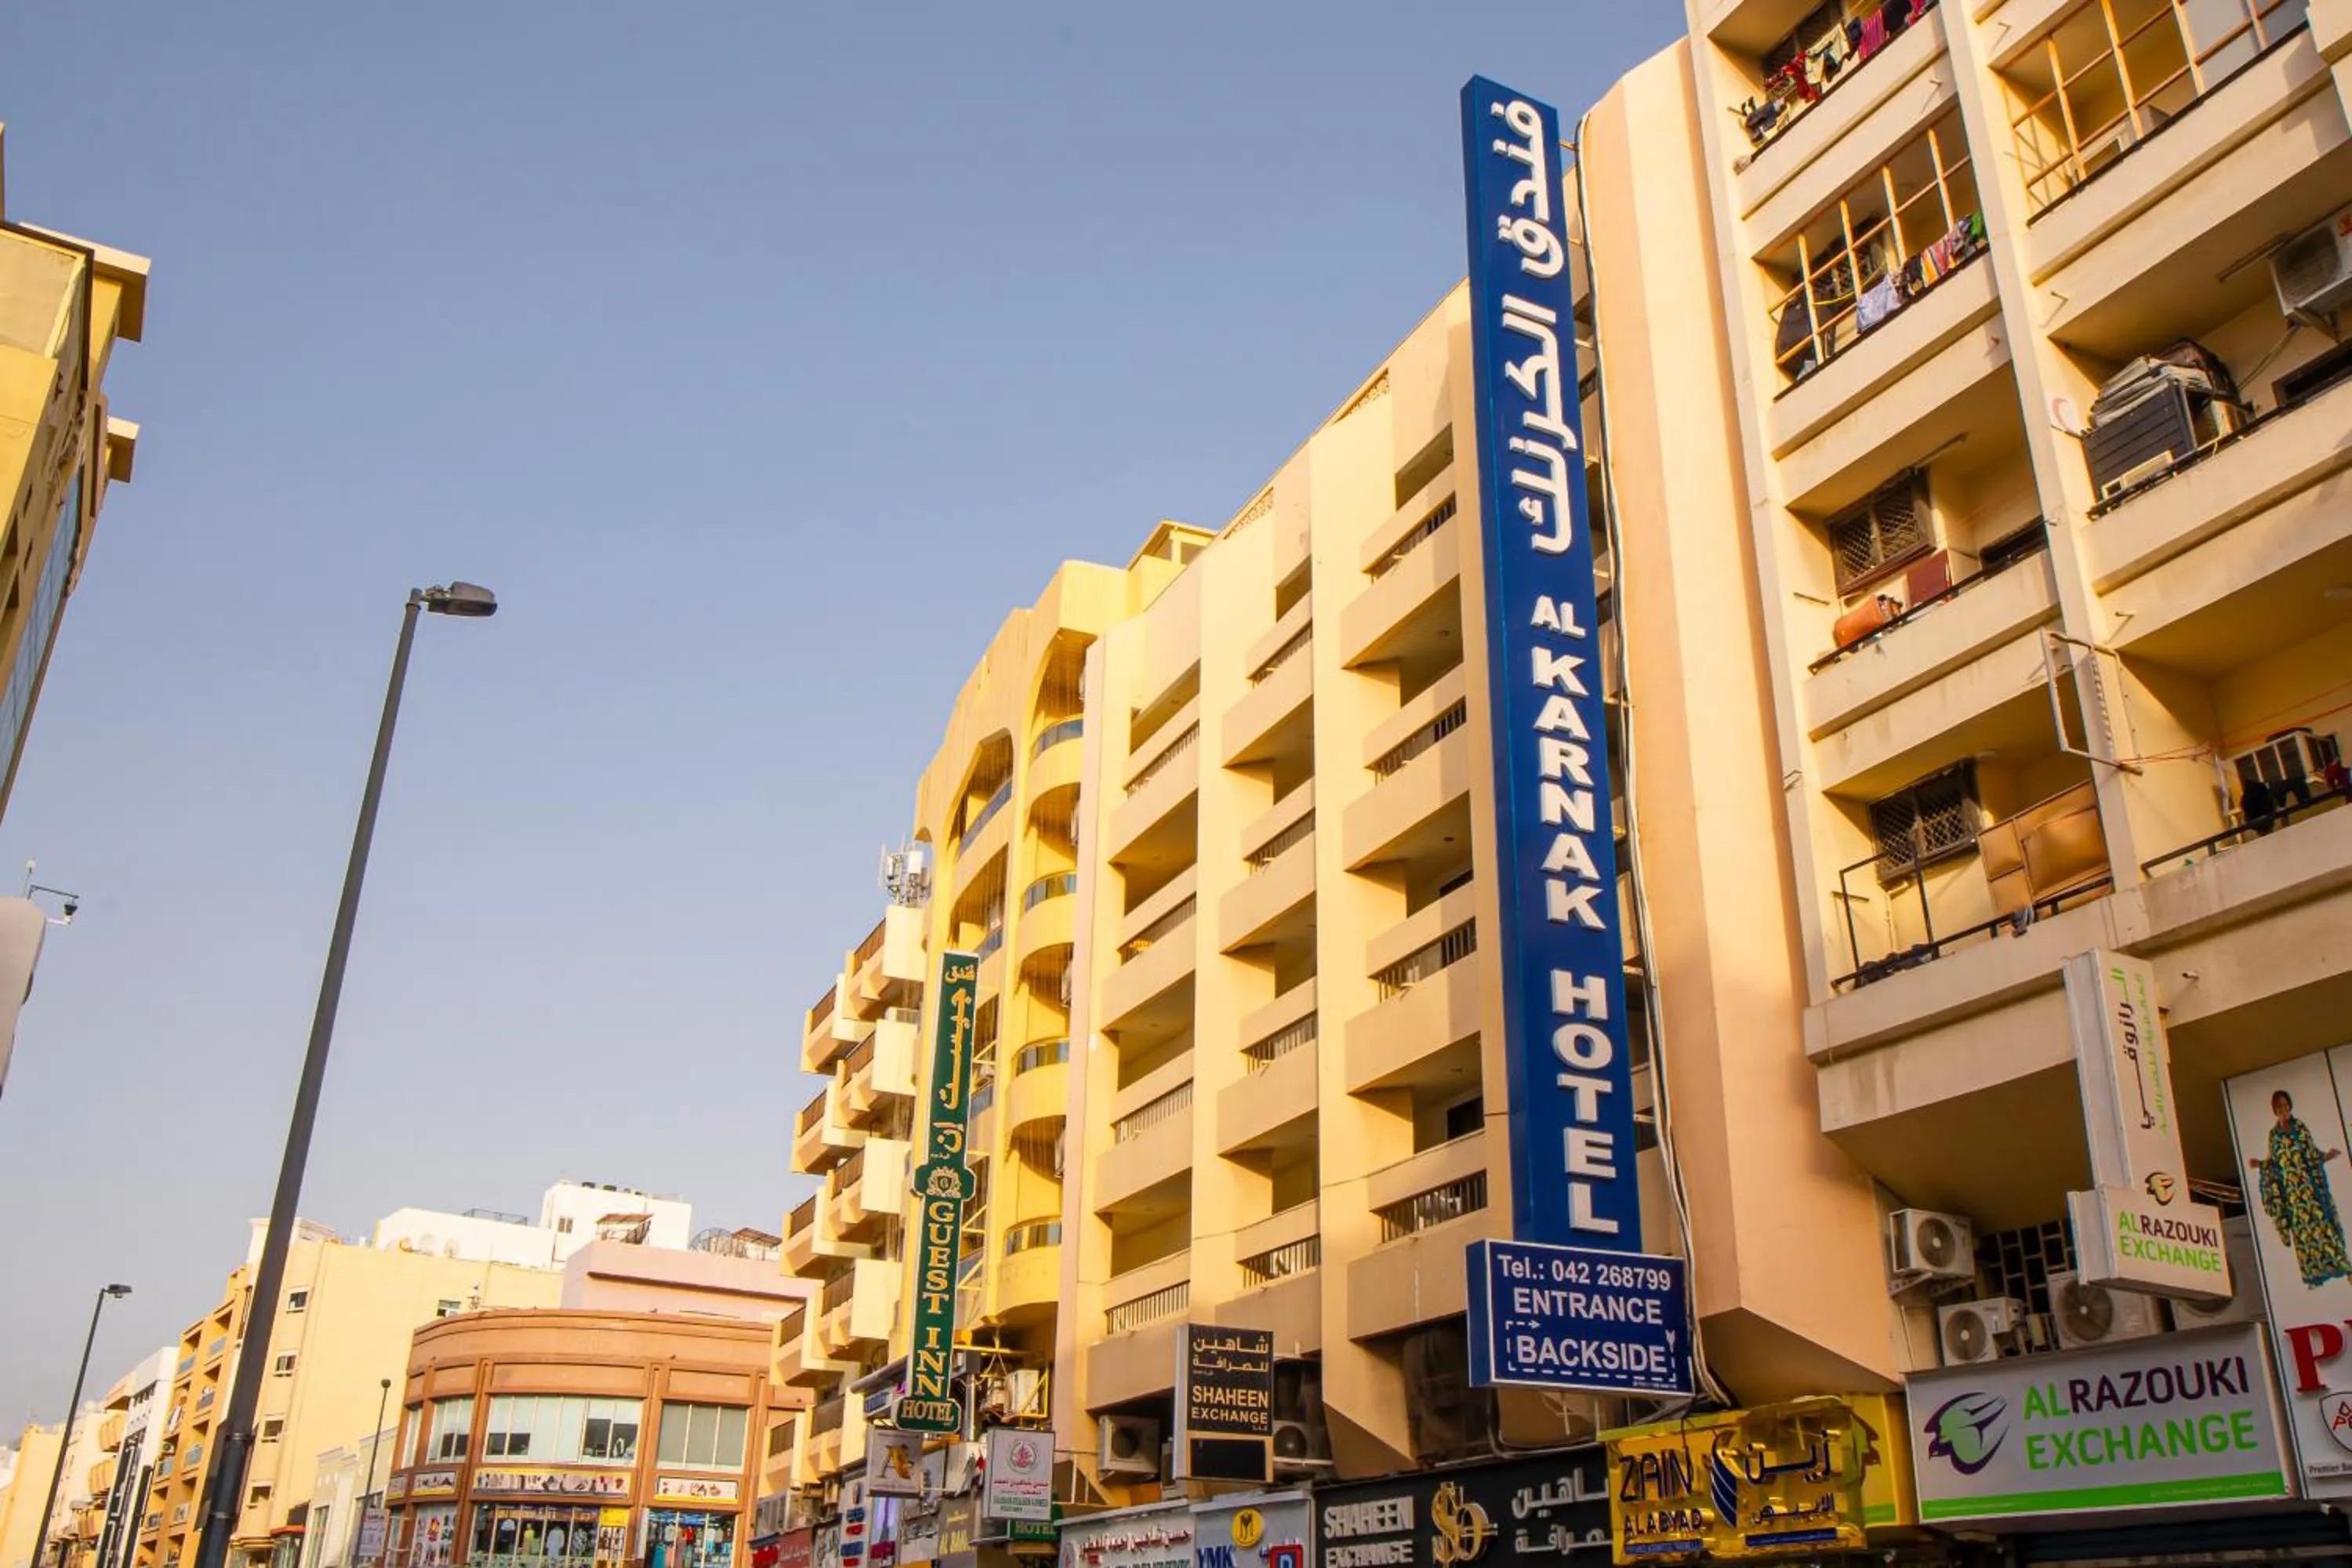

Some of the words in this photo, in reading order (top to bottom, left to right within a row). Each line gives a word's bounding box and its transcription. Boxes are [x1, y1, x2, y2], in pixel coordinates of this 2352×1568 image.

[1491, 100, 1565, 280] فندق
[1501, 292, 1578, 556] الكرنك
[1530, 595, 1586, 639] AL
[1531, 645, 1607, 931] KARNAK
[1550, 968, 1620, 1235] HOTEL
[922, 1200, 955, 1315] GUEST
[1552, 1260, 1590, 1285] 042
[1596, 1264, 1671, 1291] 268799
[2119, 1235, 2222, 1272] EXCHANGE
[1513, 1287, 1663, 1325] ENTRANCE
[914, 1327, 947, 1398] INN
[1192, 1335, 1269, 1354] شاهين
[1192, 1354, 1269, 1373] للصرافة
[1516, 1334, 1668, 1373] BACKSIDE
[2284, 1319, 2352, 1393] P
[902, 1399, 954, 1422] HOTEL
[1191, 1406, 1269, 1425] EXCHANGE
[1192, 1385, 1269, 1409] SHAHEEN
[2026, 1411, 2259, 1471] EXCHANGE
[1618, 1444, 1693, 1503] ZAIN
[1323, 1495, 1414, 1540] SHAHEEN
[1325, 1539, 1413, 1568] EXCHANGE
